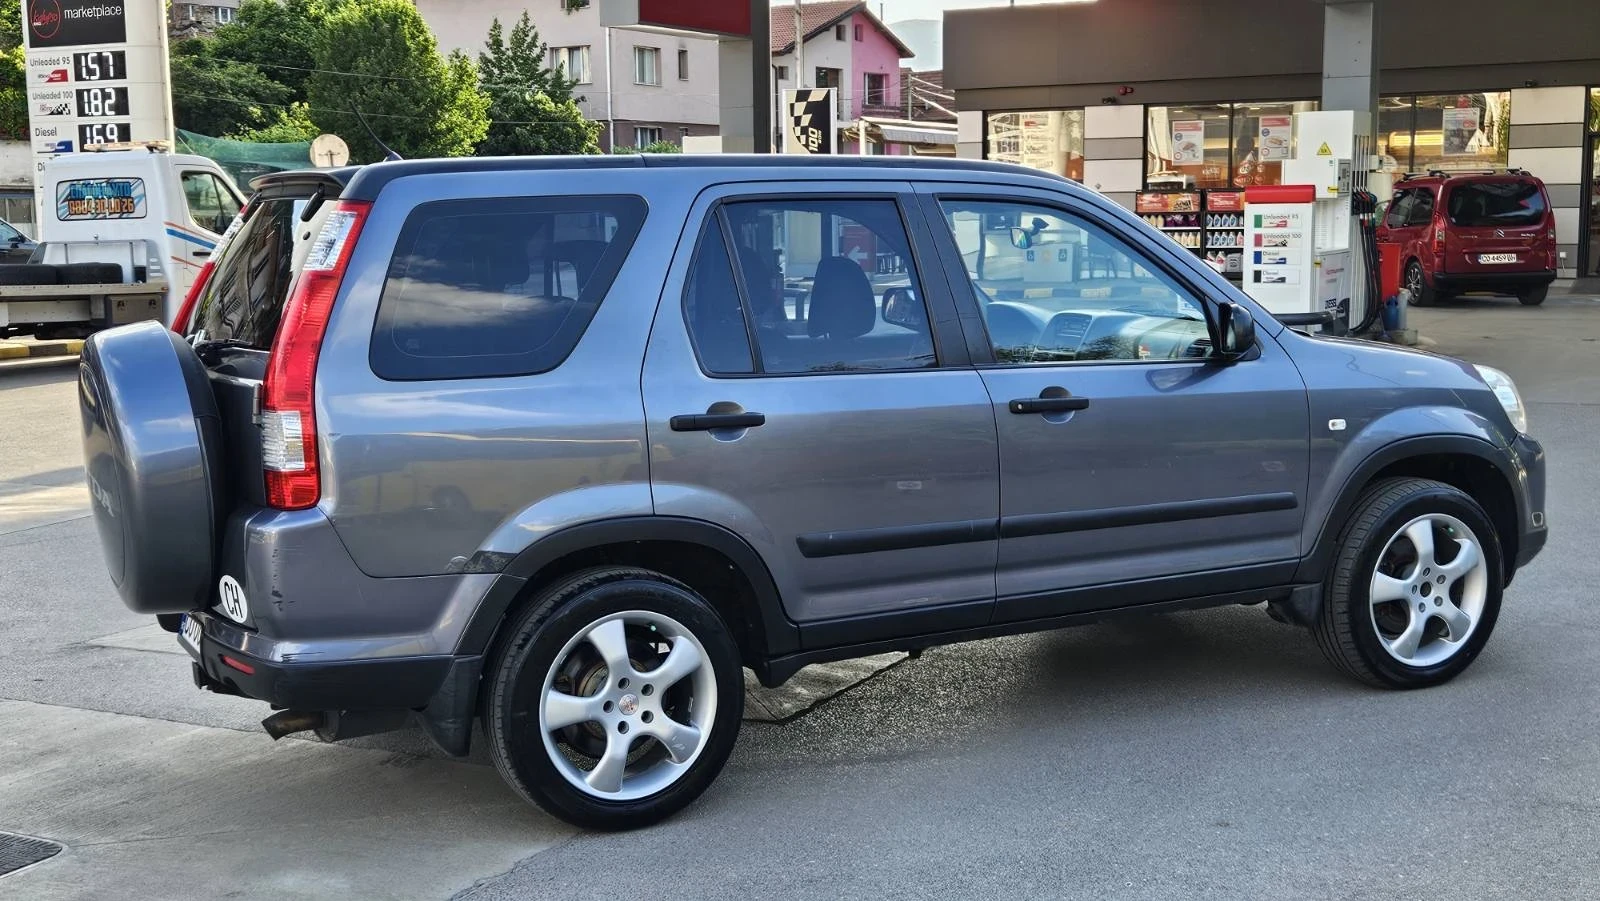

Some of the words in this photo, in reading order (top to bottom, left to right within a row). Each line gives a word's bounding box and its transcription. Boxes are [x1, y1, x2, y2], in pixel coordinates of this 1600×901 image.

[64, 4, 122, 20] marketplace
[30, 58, 61, 67] Unleaded
[62, 57, 71, 65] 95
[32, 92, 61, 100] Unleaded
[62, 91, 74, 99] 100
[35, 127, 58, 137] Diesel
[808, 127, 819, 152] 100
[224, 581, 243, 619] CH
